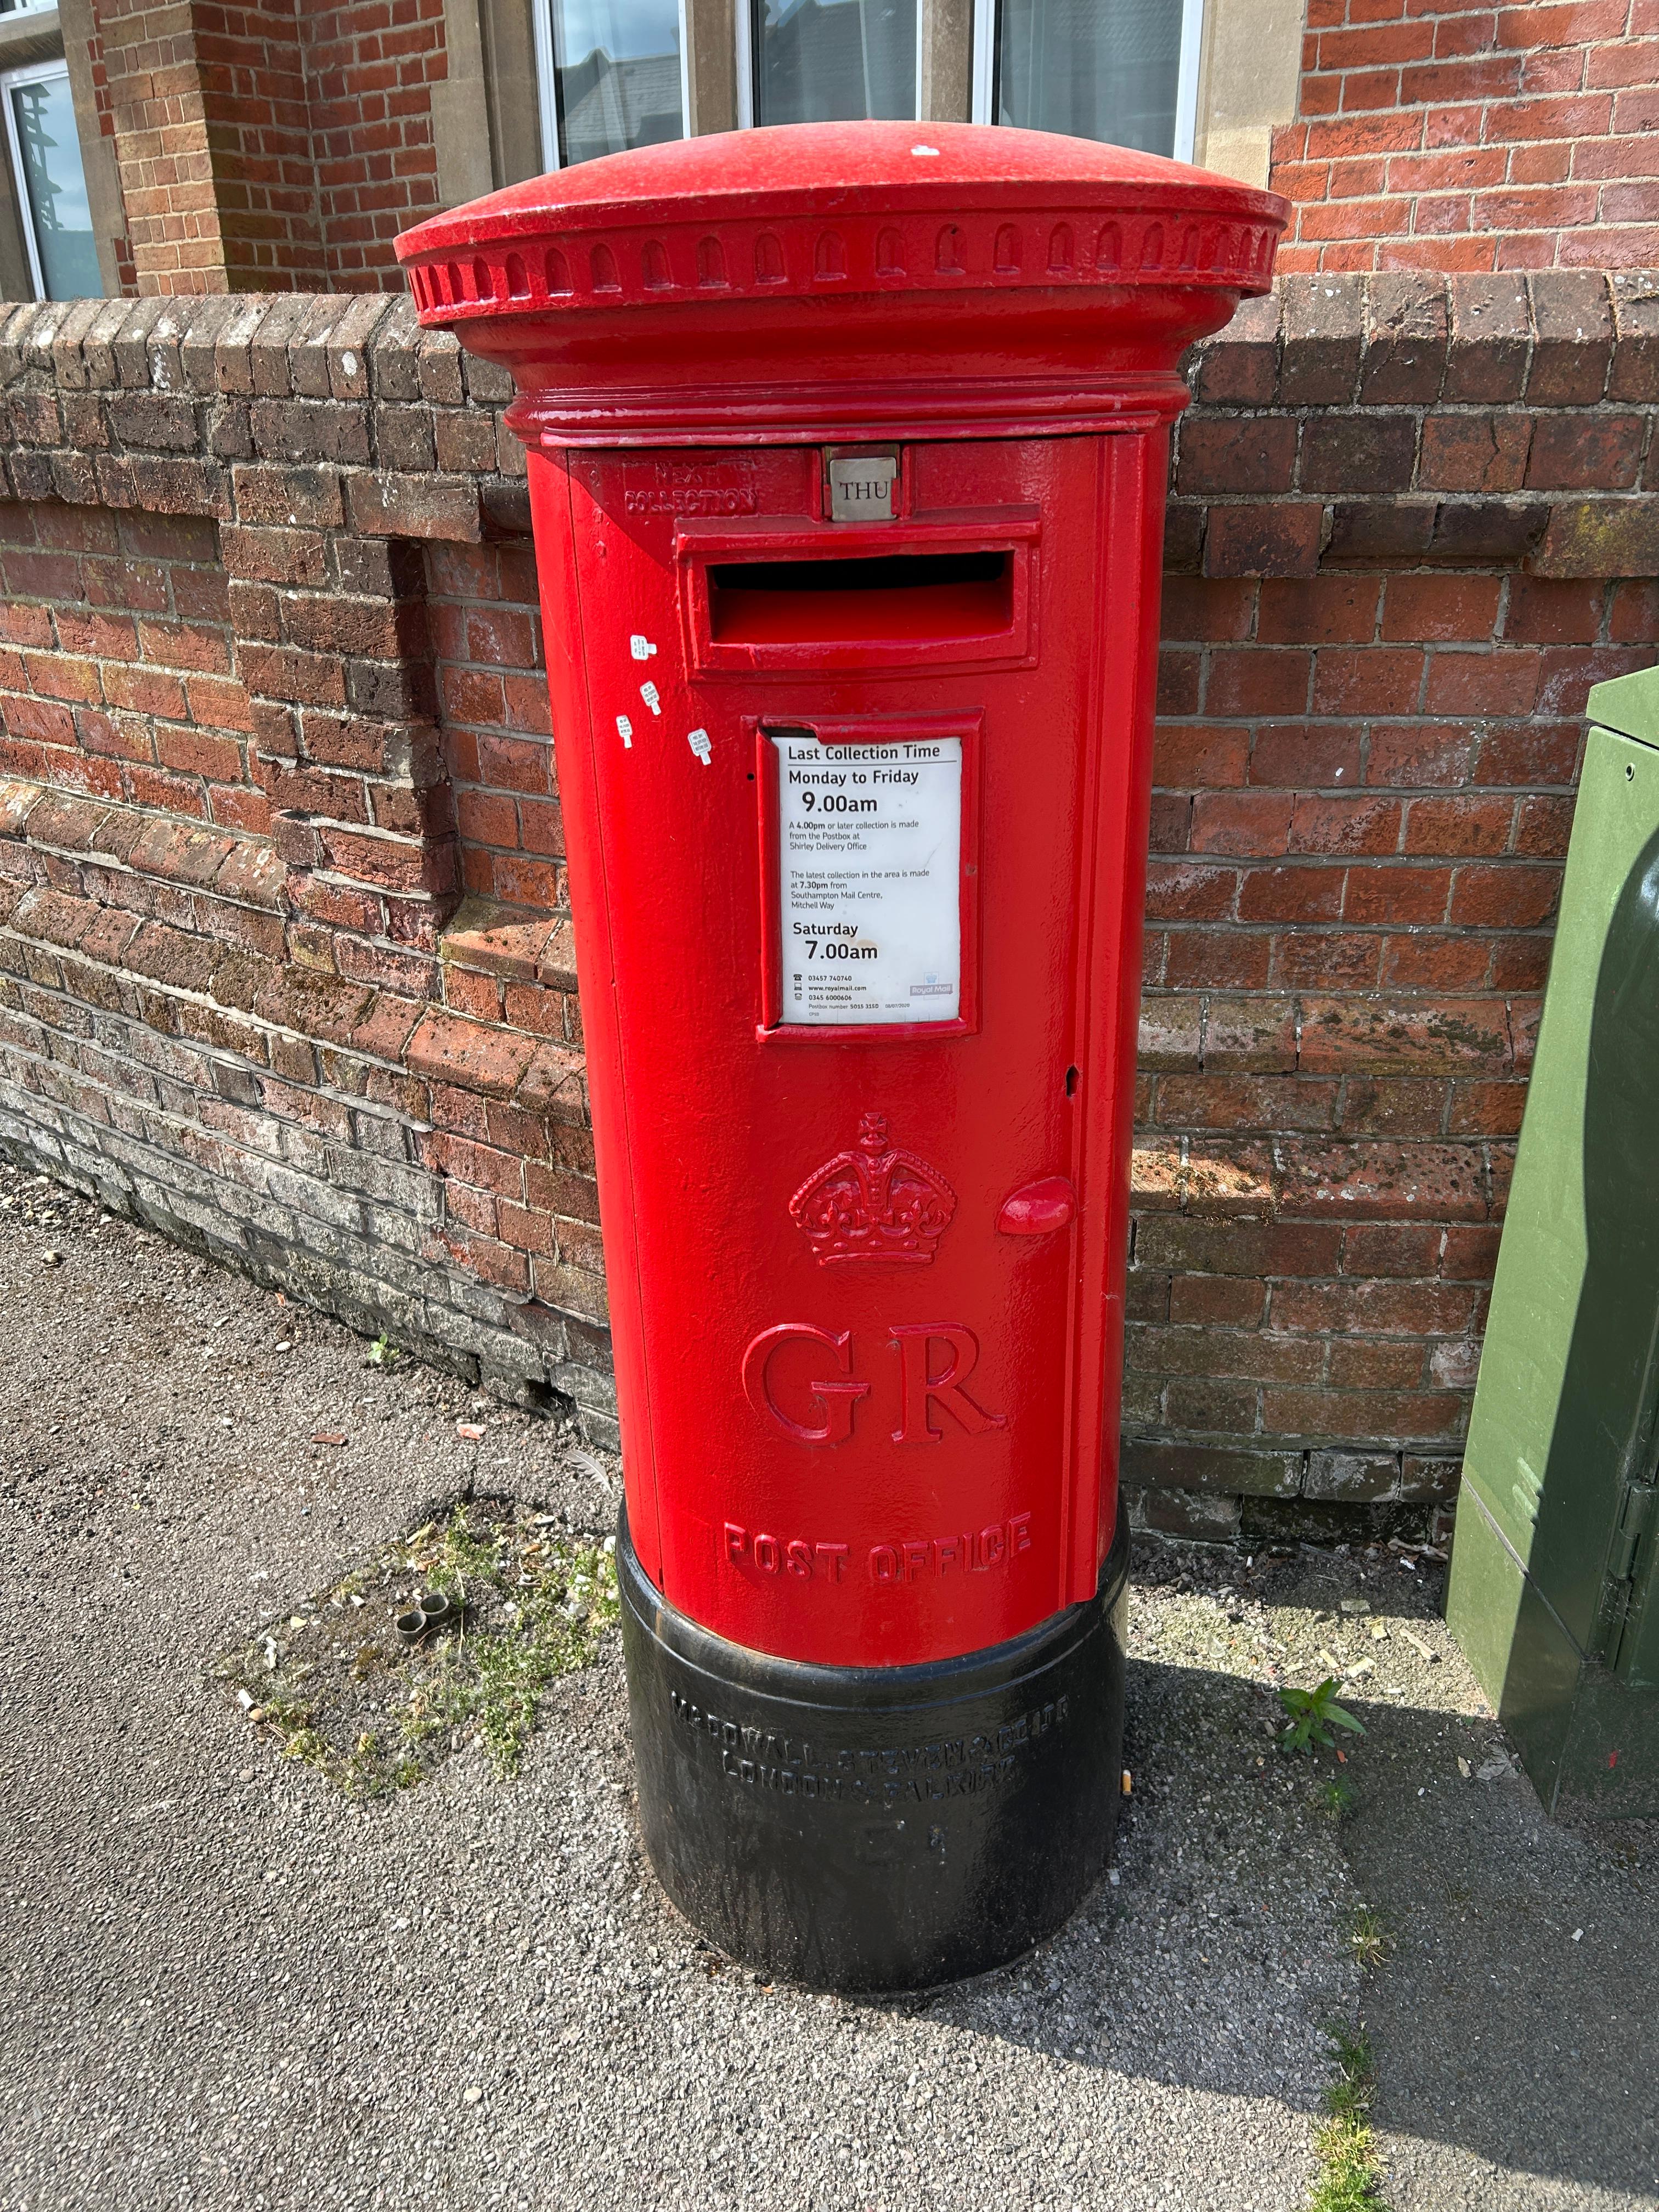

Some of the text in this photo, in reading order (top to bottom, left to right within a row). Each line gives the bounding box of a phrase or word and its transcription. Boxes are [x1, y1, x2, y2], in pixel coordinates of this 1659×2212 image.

[839, 481, 889, 501] THU
[624, 488, 758, 514] COLLECTION
[788, 745, 940, 760] Last Collection Time
[789, 769, 918, 786] Monday to Friday
[802, 791, 877, 812] 9.00am
[797, 822, 825, 831] 4.00pm
[856, 821, 889, 830] collection
[789, 843, 814, 851] Shirley
[816, 843, 845, 851] Delivery
[800, 882, 828, 890] 7.30pm
[791, 892, 838, 901] Southampton
[857, 891, 883, 900] Centre,
[819, 901, 834, 910] Way
[793, 923, 858, 938] Saturday
[805, 940, 877, 960] 7.00am
[809, 984, 866, 992] www.royalmail.com
[742, 1321, 1007, 1447] GR
[724, 1511, 1031, 1584] POST OFFICE
[722, 1750, 843, 1802] LONDON
